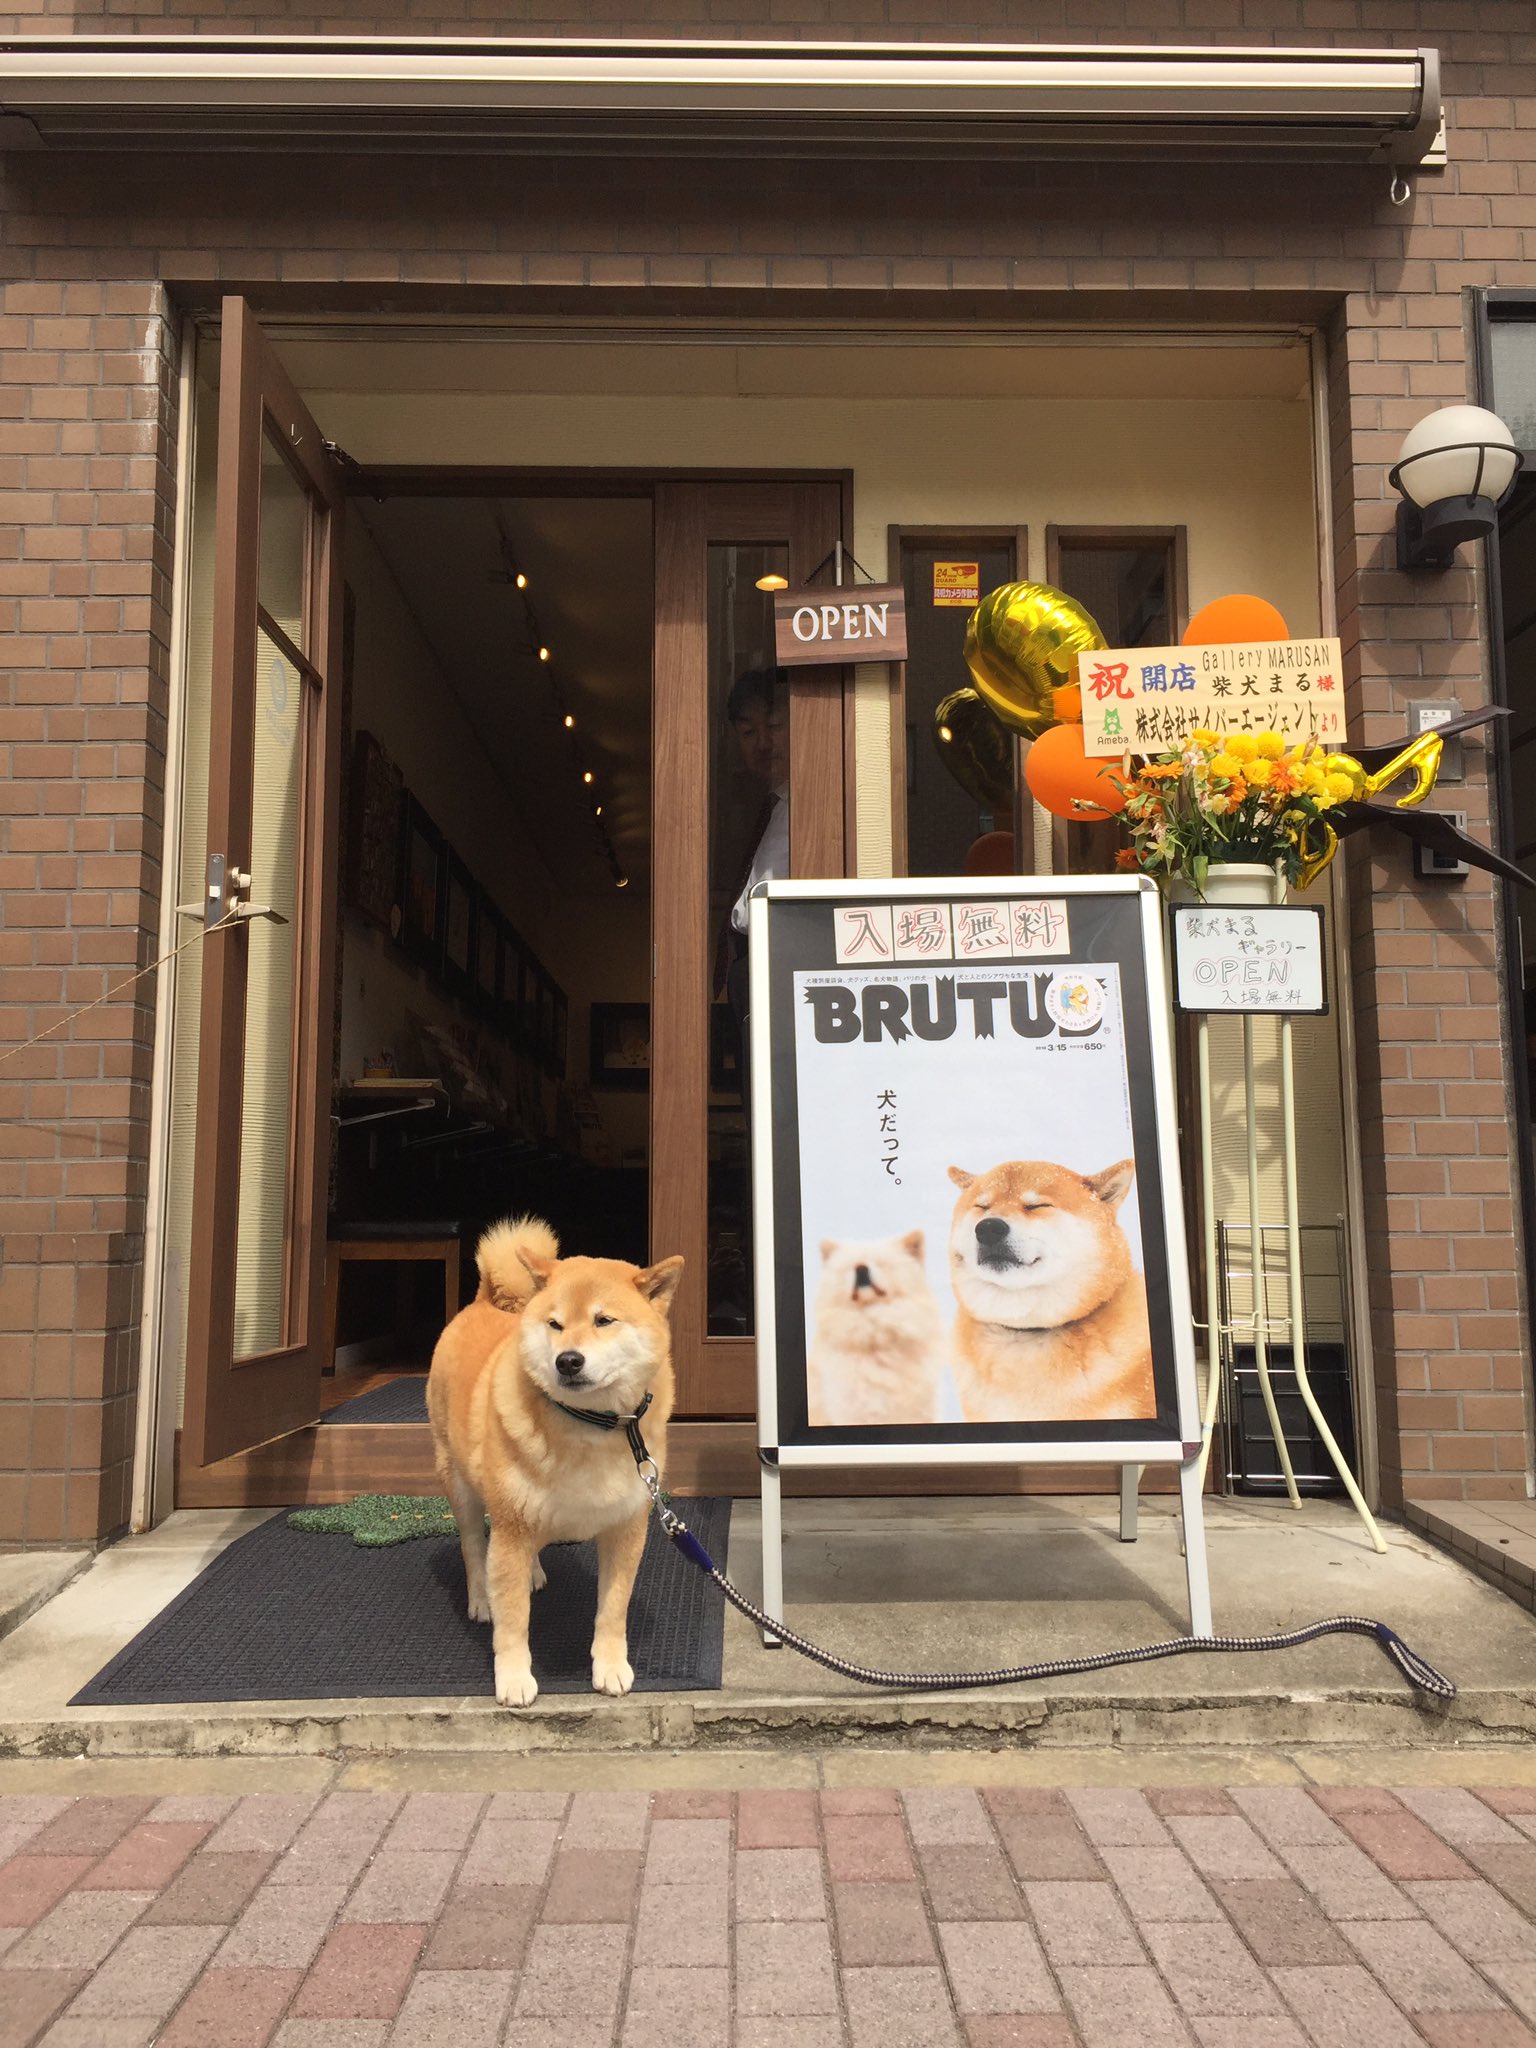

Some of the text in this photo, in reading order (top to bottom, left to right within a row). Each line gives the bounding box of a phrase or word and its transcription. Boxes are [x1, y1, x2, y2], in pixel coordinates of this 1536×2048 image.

[792, 603, 890, 642] OPEN
[1202, 644, 1330, 672] Gallery MARUSAN
[1087, 662, 1197, 701] 祝 開店
[1097, 735, 1129, 745] Ameba
[843, 901, 1065, 956] 入場無料
[1186, 915, 1258, 938] 柴犬まる
[1237, 939, 1307, 956] ギャラリー
[1195, 958, 1289, 985] OPEN
[803, 971, 1107, 1046] BRUTU
[1221, 988, 1302, 1005] 入場無料
[876, 1089, 902, 1186] 犬だって。
